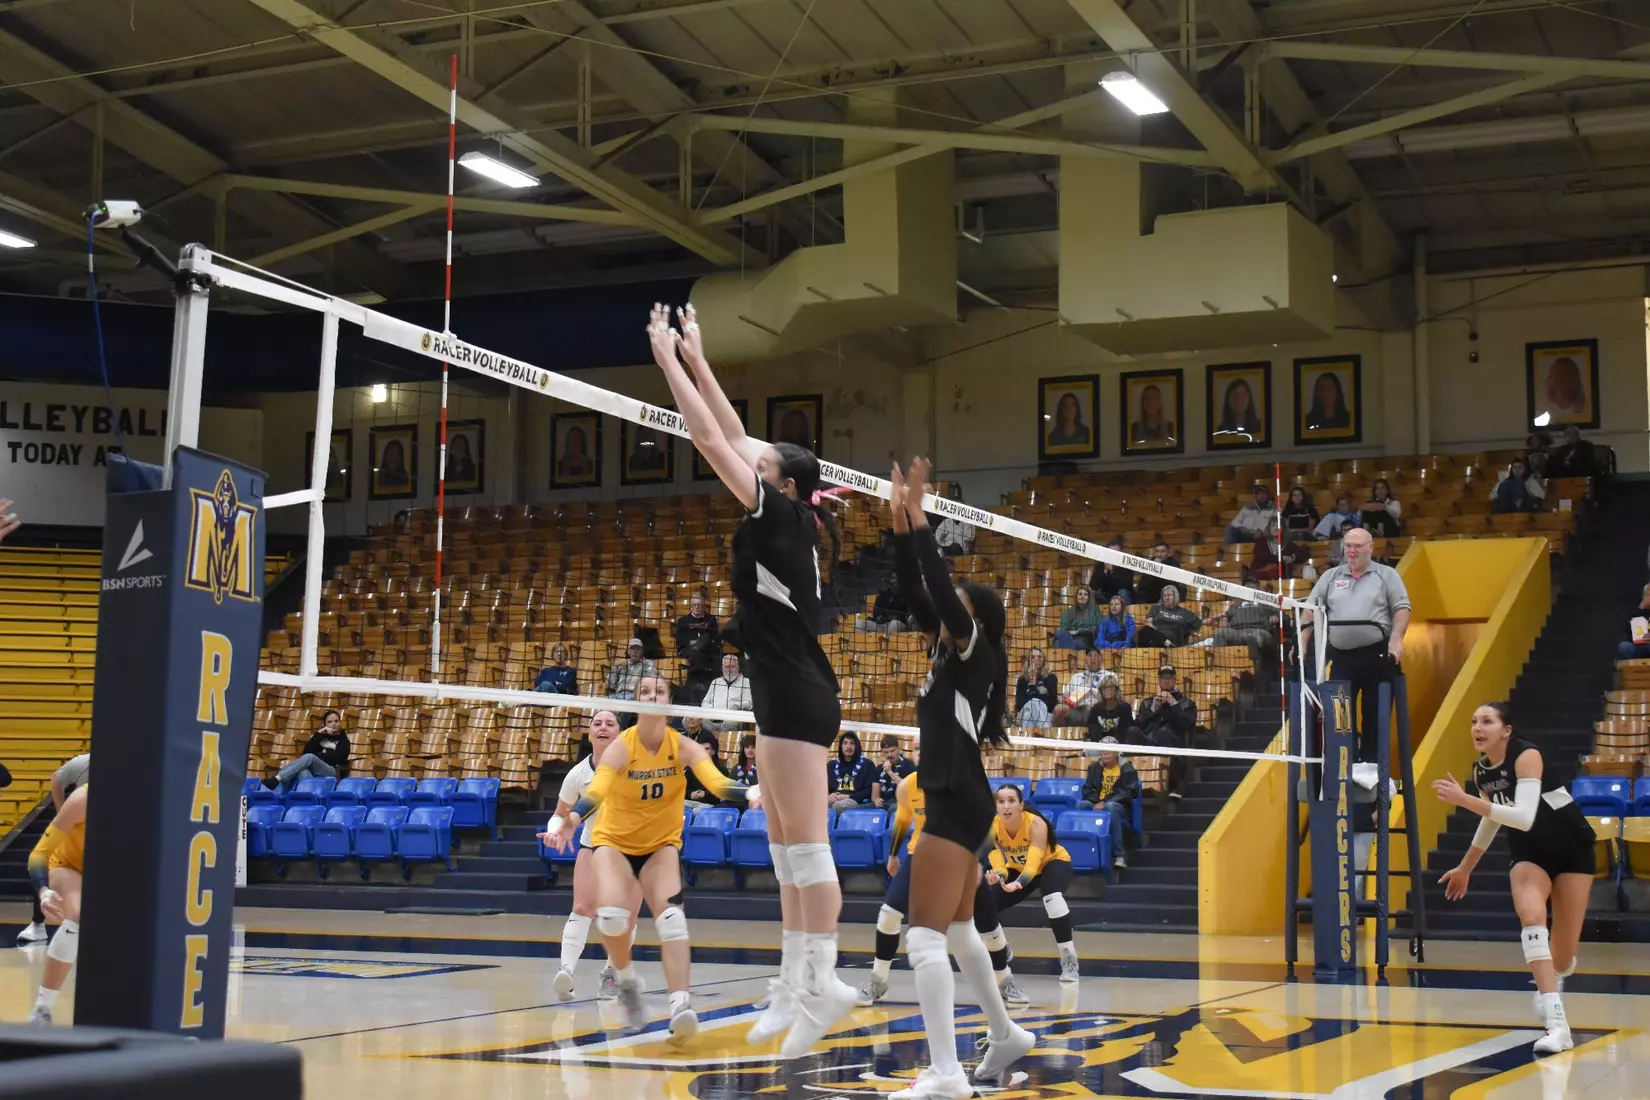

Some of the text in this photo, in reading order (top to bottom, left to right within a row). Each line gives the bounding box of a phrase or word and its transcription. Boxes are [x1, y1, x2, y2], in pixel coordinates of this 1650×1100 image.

[433, 337, 538, 385] RACER VOLLEYBALL
[648, 409, 677, 429] RACER
[8, 441, 83, 467] TODAY
[835, 467, 873, 491] VOLLEYBALL
[628, 766, 678, 780] MURRAY STATE
[641, 782, 665, 801] 10
[1336, 746, 1351, 963] RACERS
